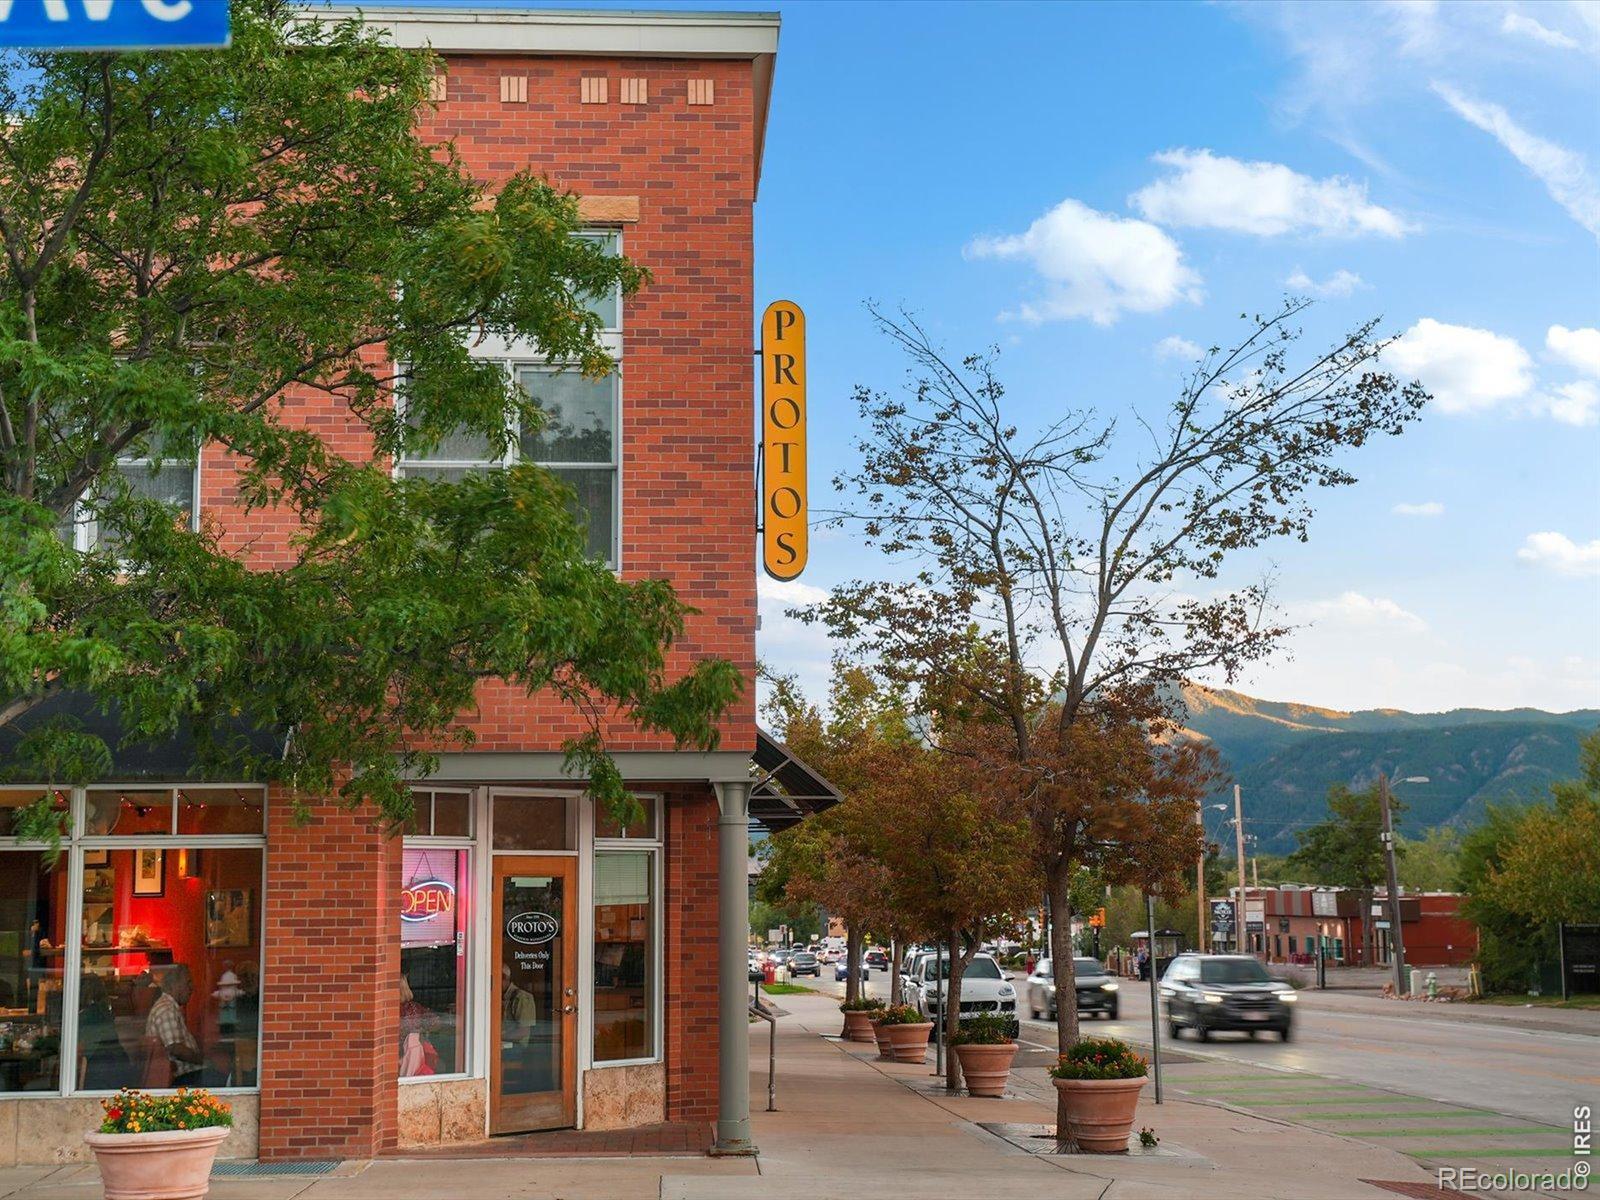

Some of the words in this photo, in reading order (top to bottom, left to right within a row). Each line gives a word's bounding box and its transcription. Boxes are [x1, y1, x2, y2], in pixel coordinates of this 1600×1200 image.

[770, 310, 801, 564] PROTOS
[401, 890, 451, 912] OPEN
[511, 921, 555, 933] PROTO'S
[538, 951, 550, 960] Only
[521, 962, 531, 970] This
[532, 962, 544, 970] Door
